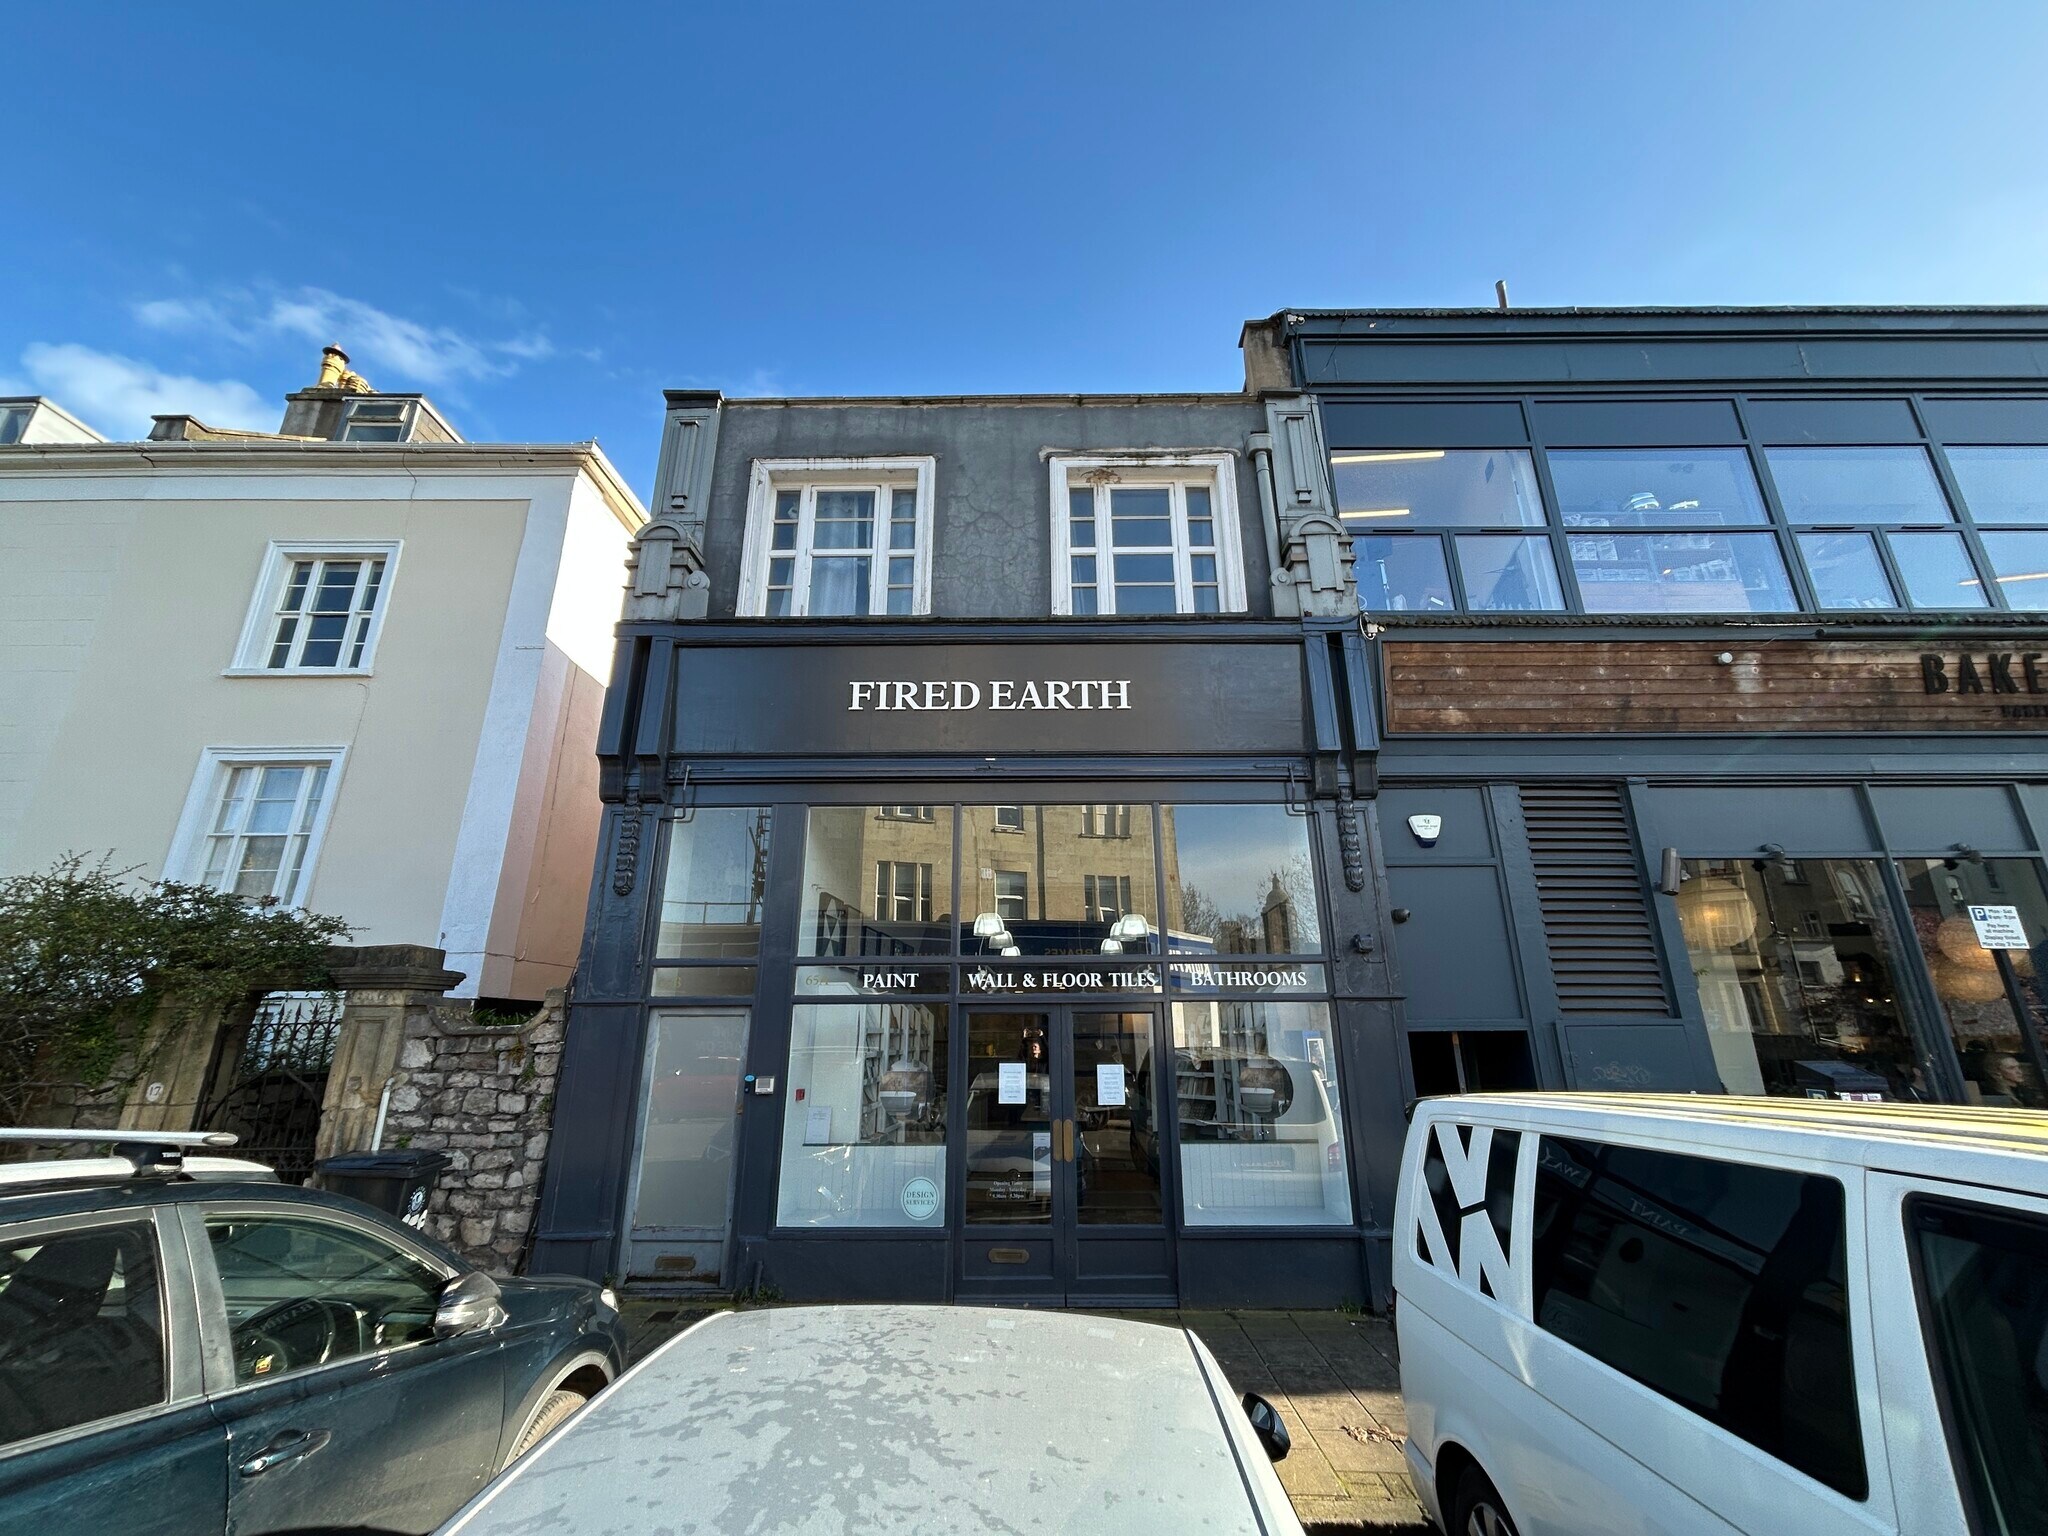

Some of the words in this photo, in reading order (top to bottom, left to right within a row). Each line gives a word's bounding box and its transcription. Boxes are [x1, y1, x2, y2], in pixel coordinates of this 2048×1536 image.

[1921, 652, 2048, 695] BAKE
[848, 681, 981, 711] FIRED
[988, 680, 1132, 710] EARTH
[862, 973, 920, 989] PAINT
[967, 973, 1017, 989] WALL
[1022, 973, 1037, 988] &
[1042, 972, 1104, 988] FLOOR
[1108, 972, 1157, 988] TILES
[1191, 971, 1307, 987] BATHROOMS
[149, 1086, 162, 1096] 17
